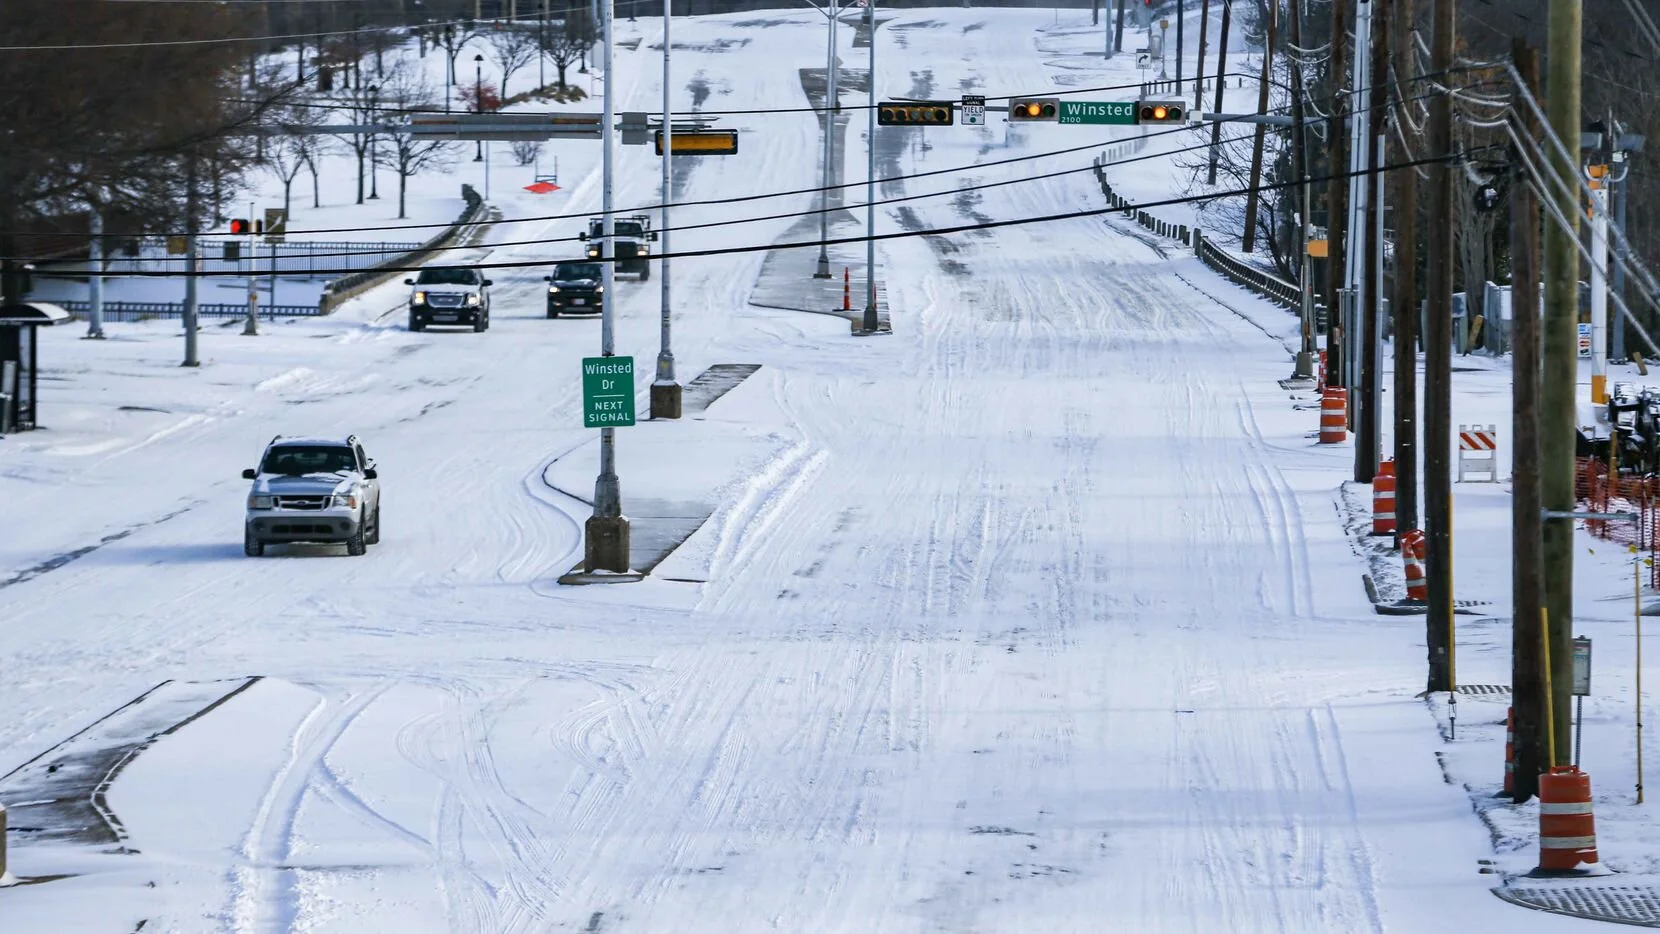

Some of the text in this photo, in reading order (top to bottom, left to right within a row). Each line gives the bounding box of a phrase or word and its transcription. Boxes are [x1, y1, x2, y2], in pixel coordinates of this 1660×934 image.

[963, 106, 984, 114] YIELD
[1067, 103, 1133, 116] Winsted
[585, 362, 632, 375] Winsted
[602, 379, 615, 390] Dr
[594, 401, 624, 411] NEXT
[588, 412, 631, 422] SIGNAL
